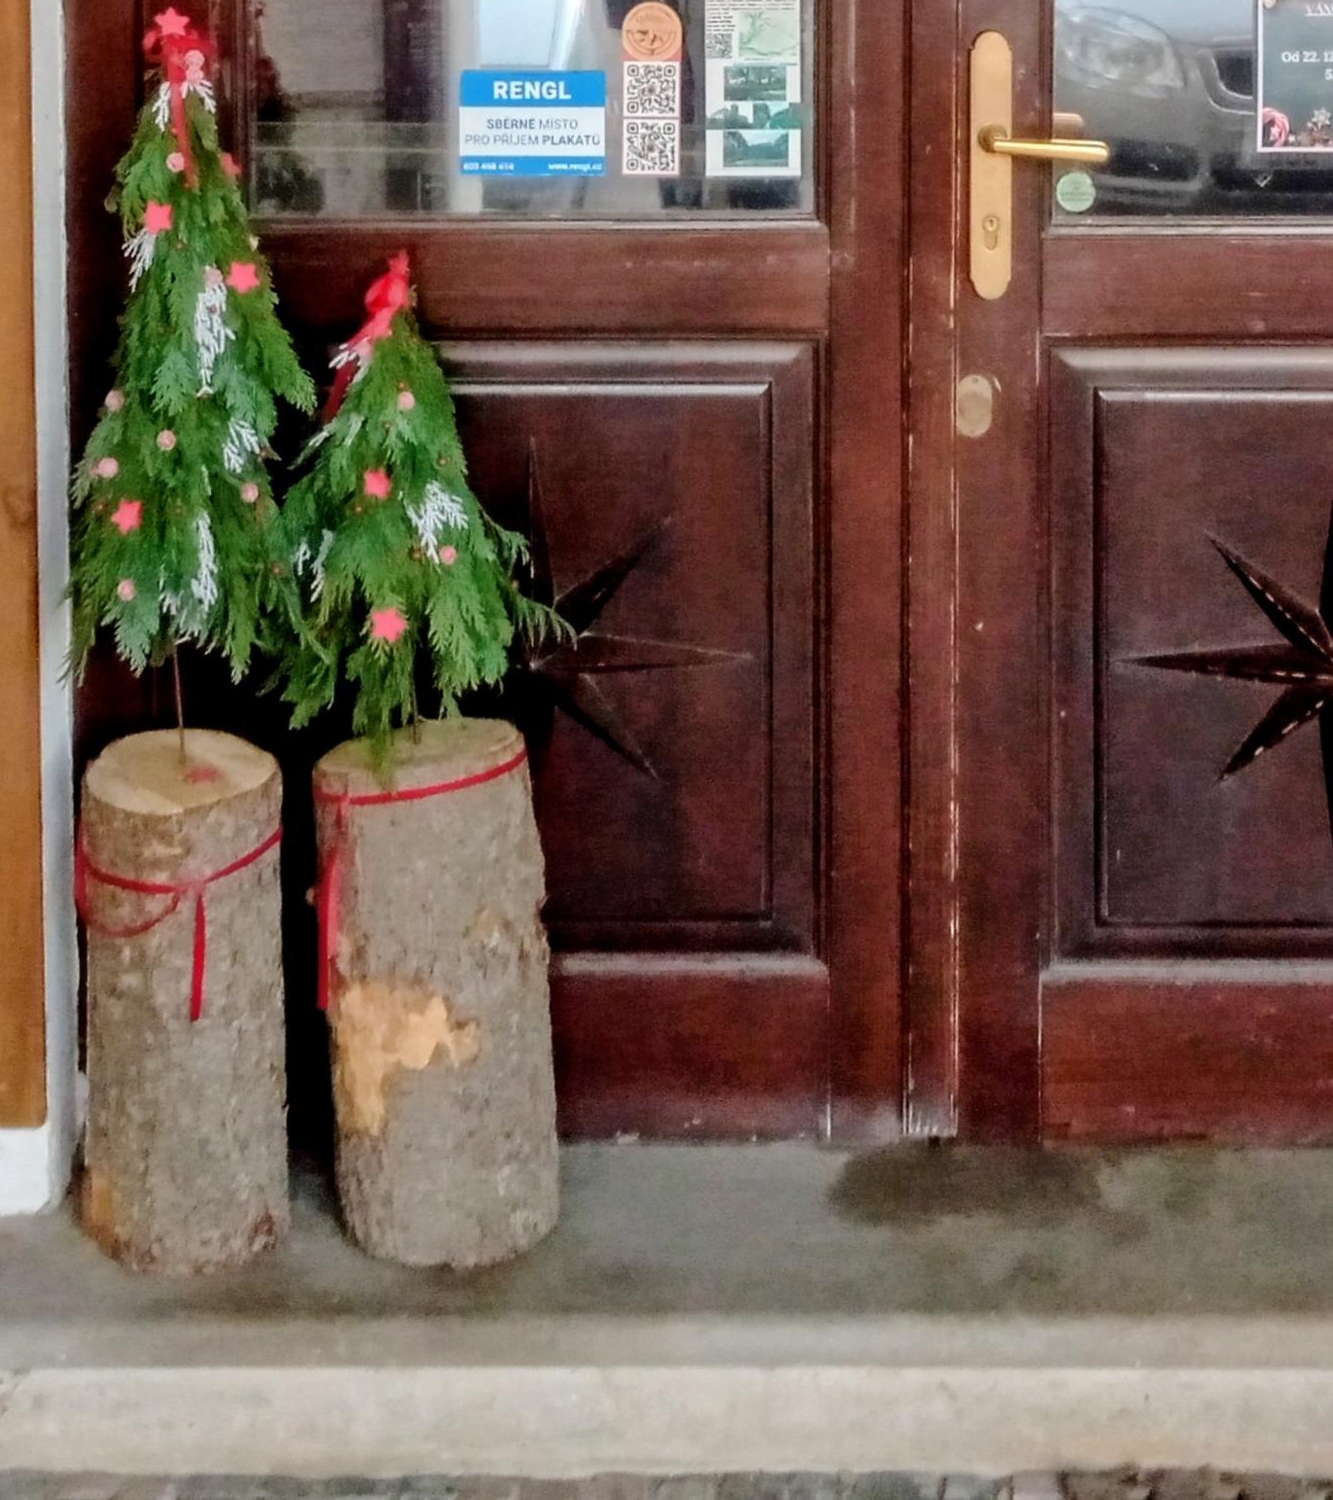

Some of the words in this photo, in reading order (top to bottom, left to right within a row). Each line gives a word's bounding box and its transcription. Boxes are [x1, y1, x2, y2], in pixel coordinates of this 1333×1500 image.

[1302, 51, 1320, 62] 22.
[493, 81, 572, 100] RENGL
[465, 134, 490, 145] PRO
[493, 133, 539, 146] PŘÍJEM
